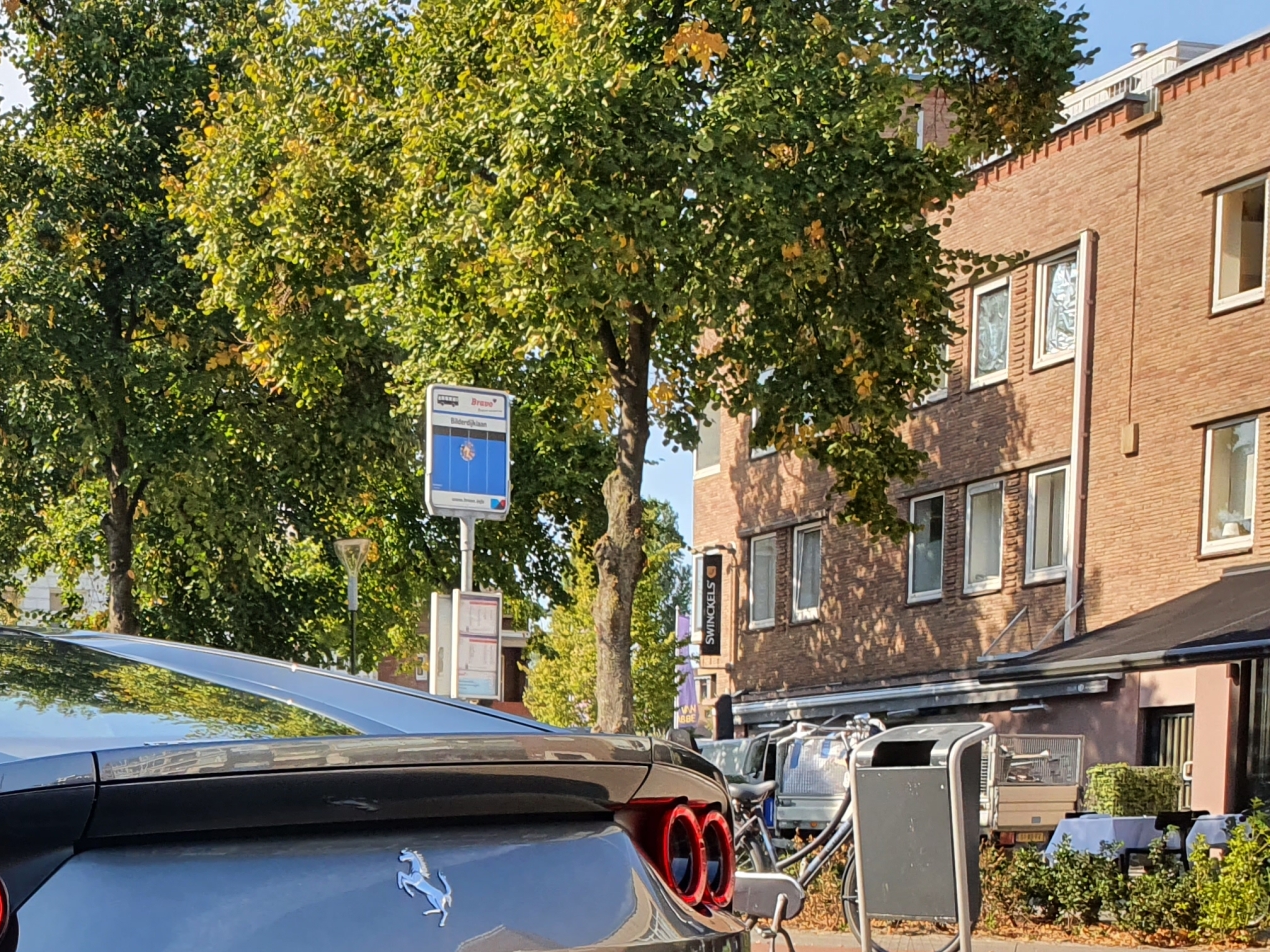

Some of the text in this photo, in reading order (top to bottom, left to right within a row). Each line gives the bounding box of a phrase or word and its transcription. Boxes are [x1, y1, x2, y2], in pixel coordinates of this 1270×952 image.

[471, 398, 493, 407] Bravo
[450, 417, 487, 428] Bilderdijklaan
[681, 704, 696, 714] VAN
